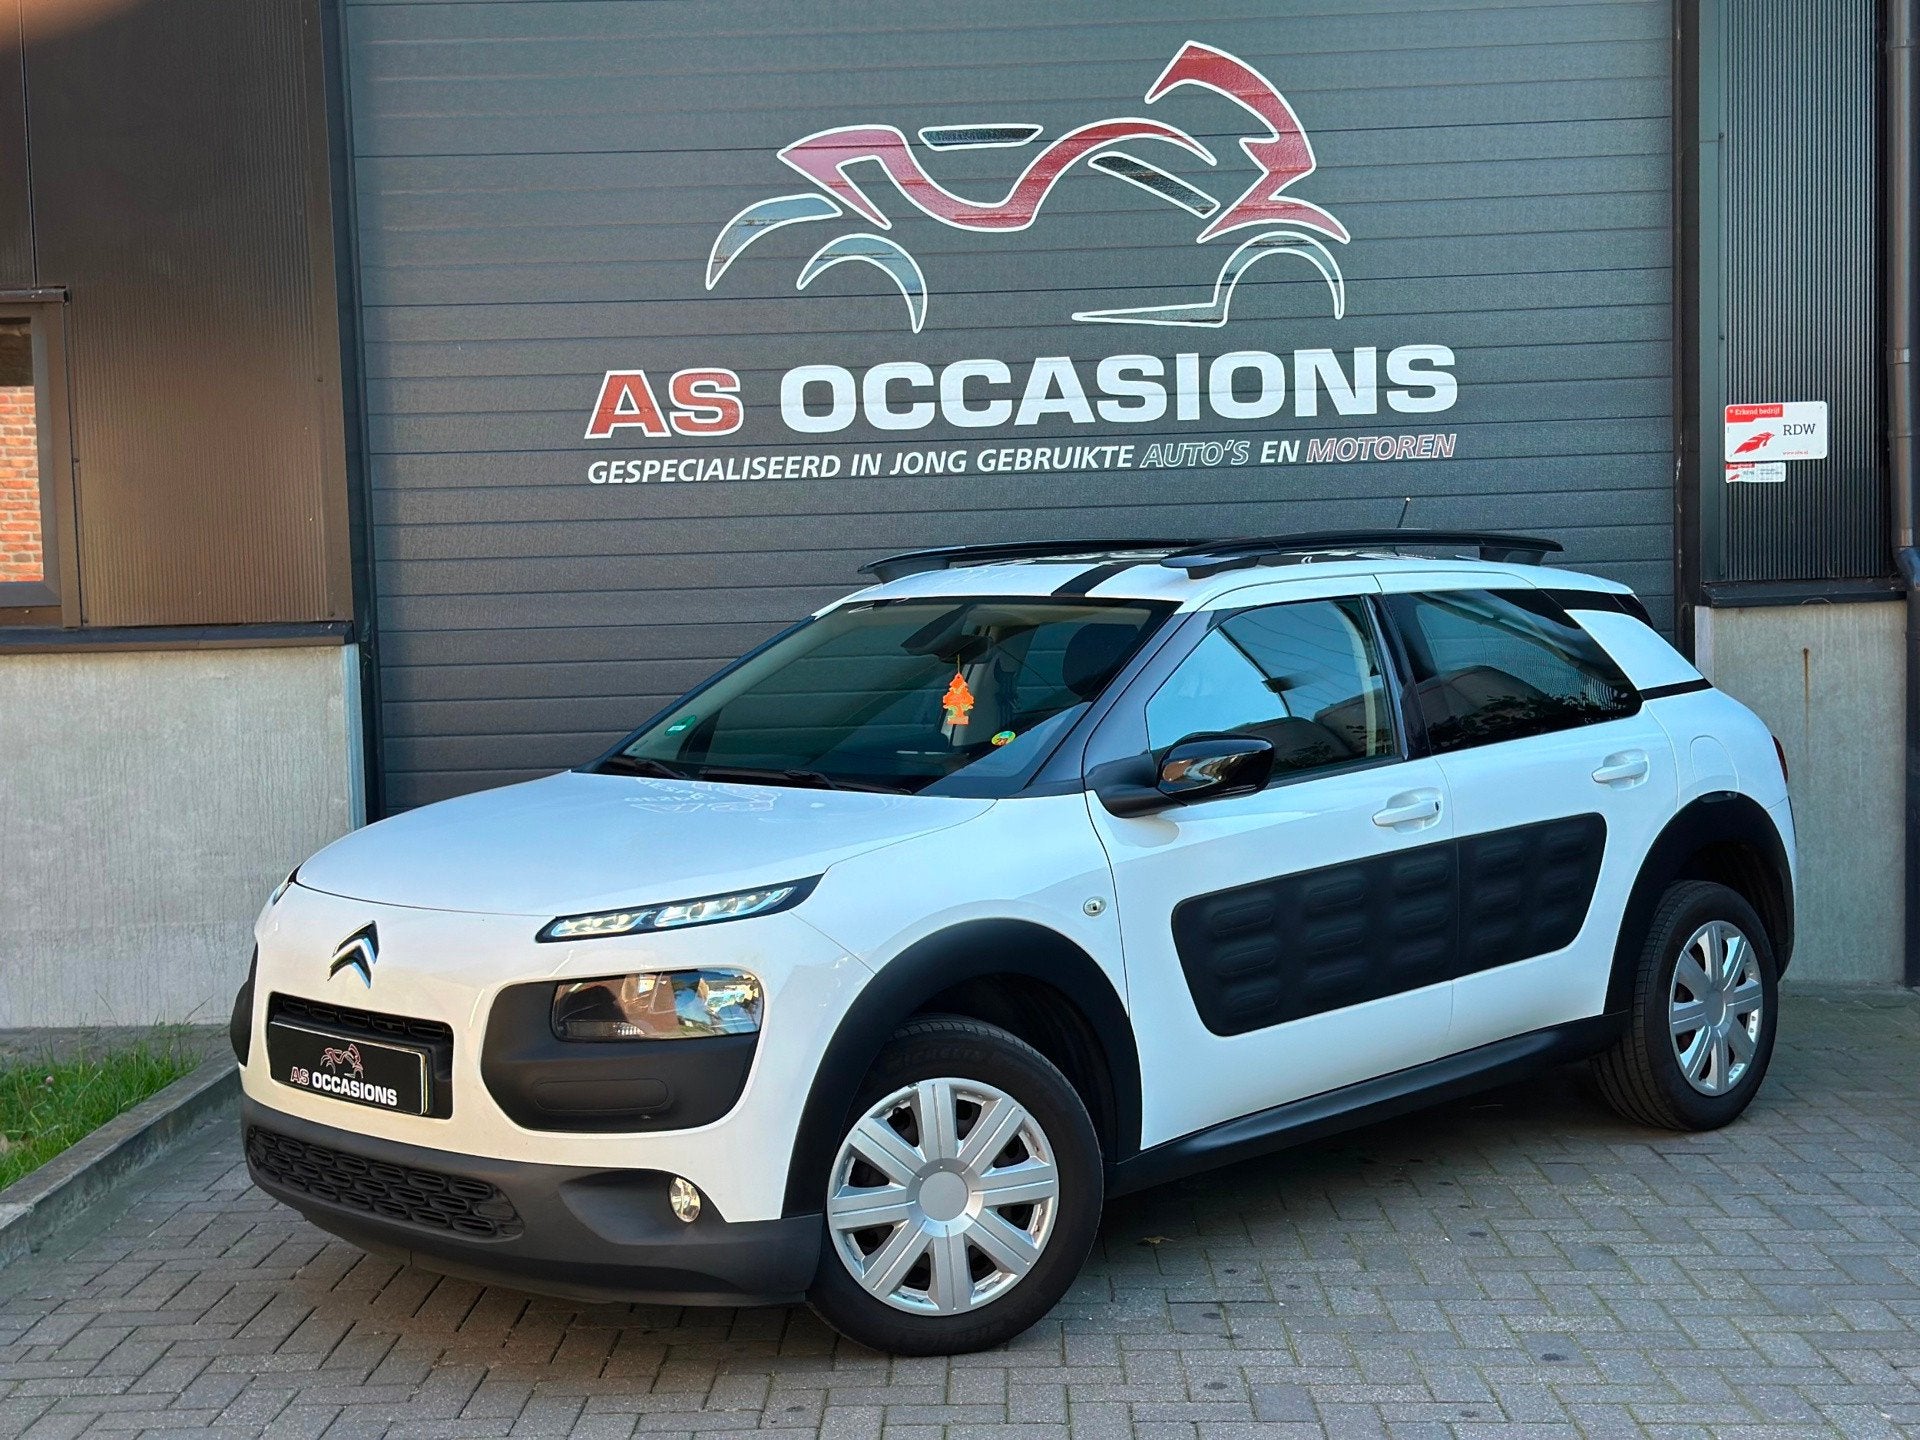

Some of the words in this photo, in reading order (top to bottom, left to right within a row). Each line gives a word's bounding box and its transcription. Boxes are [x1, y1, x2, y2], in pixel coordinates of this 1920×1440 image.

[584, 367, 744, 440] AS
[780, 344, 1458, 434] OCCASIONS
[1783, 423, 1816, 436] RDW
[587, 454, 841, 485] GESPECIALISEERD
[850, 453, 883, 477] IN
[889, 449, 967, 476] JONG
[976, 444, 1135, 473] GEBRUIKTE
[1139, 440, 1250, 469] AUTO'S
[1260, 440, 1300, 465] EN
[1306, 433, 1457, 463] MOTOREN
[290, 1066, 310, 1086] AS
[312, 1071, 398, 1106] OCCASIONS
